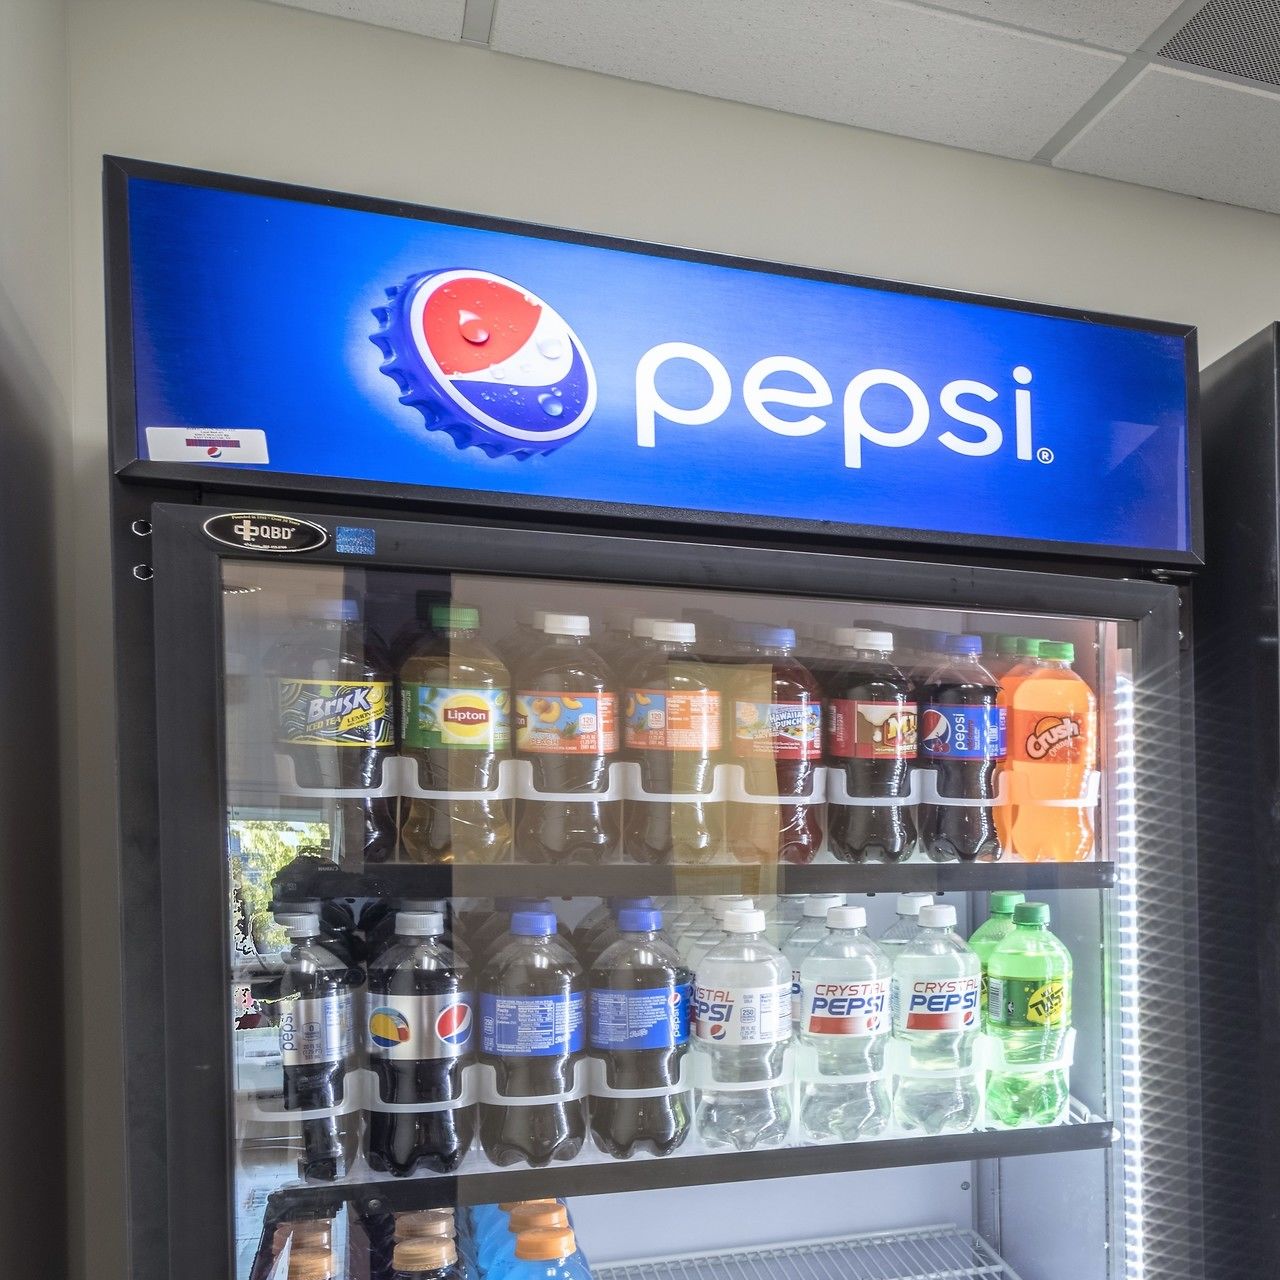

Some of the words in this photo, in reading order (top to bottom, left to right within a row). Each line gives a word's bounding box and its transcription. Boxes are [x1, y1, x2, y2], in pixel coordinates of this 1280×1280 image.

[635, 341, 1036, 469] pepsi
[260, 526, 293, 540] QBD
[306, 720, 325, 732] ICED
[326, 715, 342, 728] TEA
[447, 709, 486, 722] Lipton
[956, 712, 968, 752] pepsi
[1026, 716, 1081, 760] Crush
[815, 977, 885, 997] CRYSTAL
[912, 978, 979, 993] CRYSTAL
[810, 989, 885, 1015] PEPSI
[909, 988, 978, 1012] PEPSI
[282, 1011, 298, 1052] pepsi
